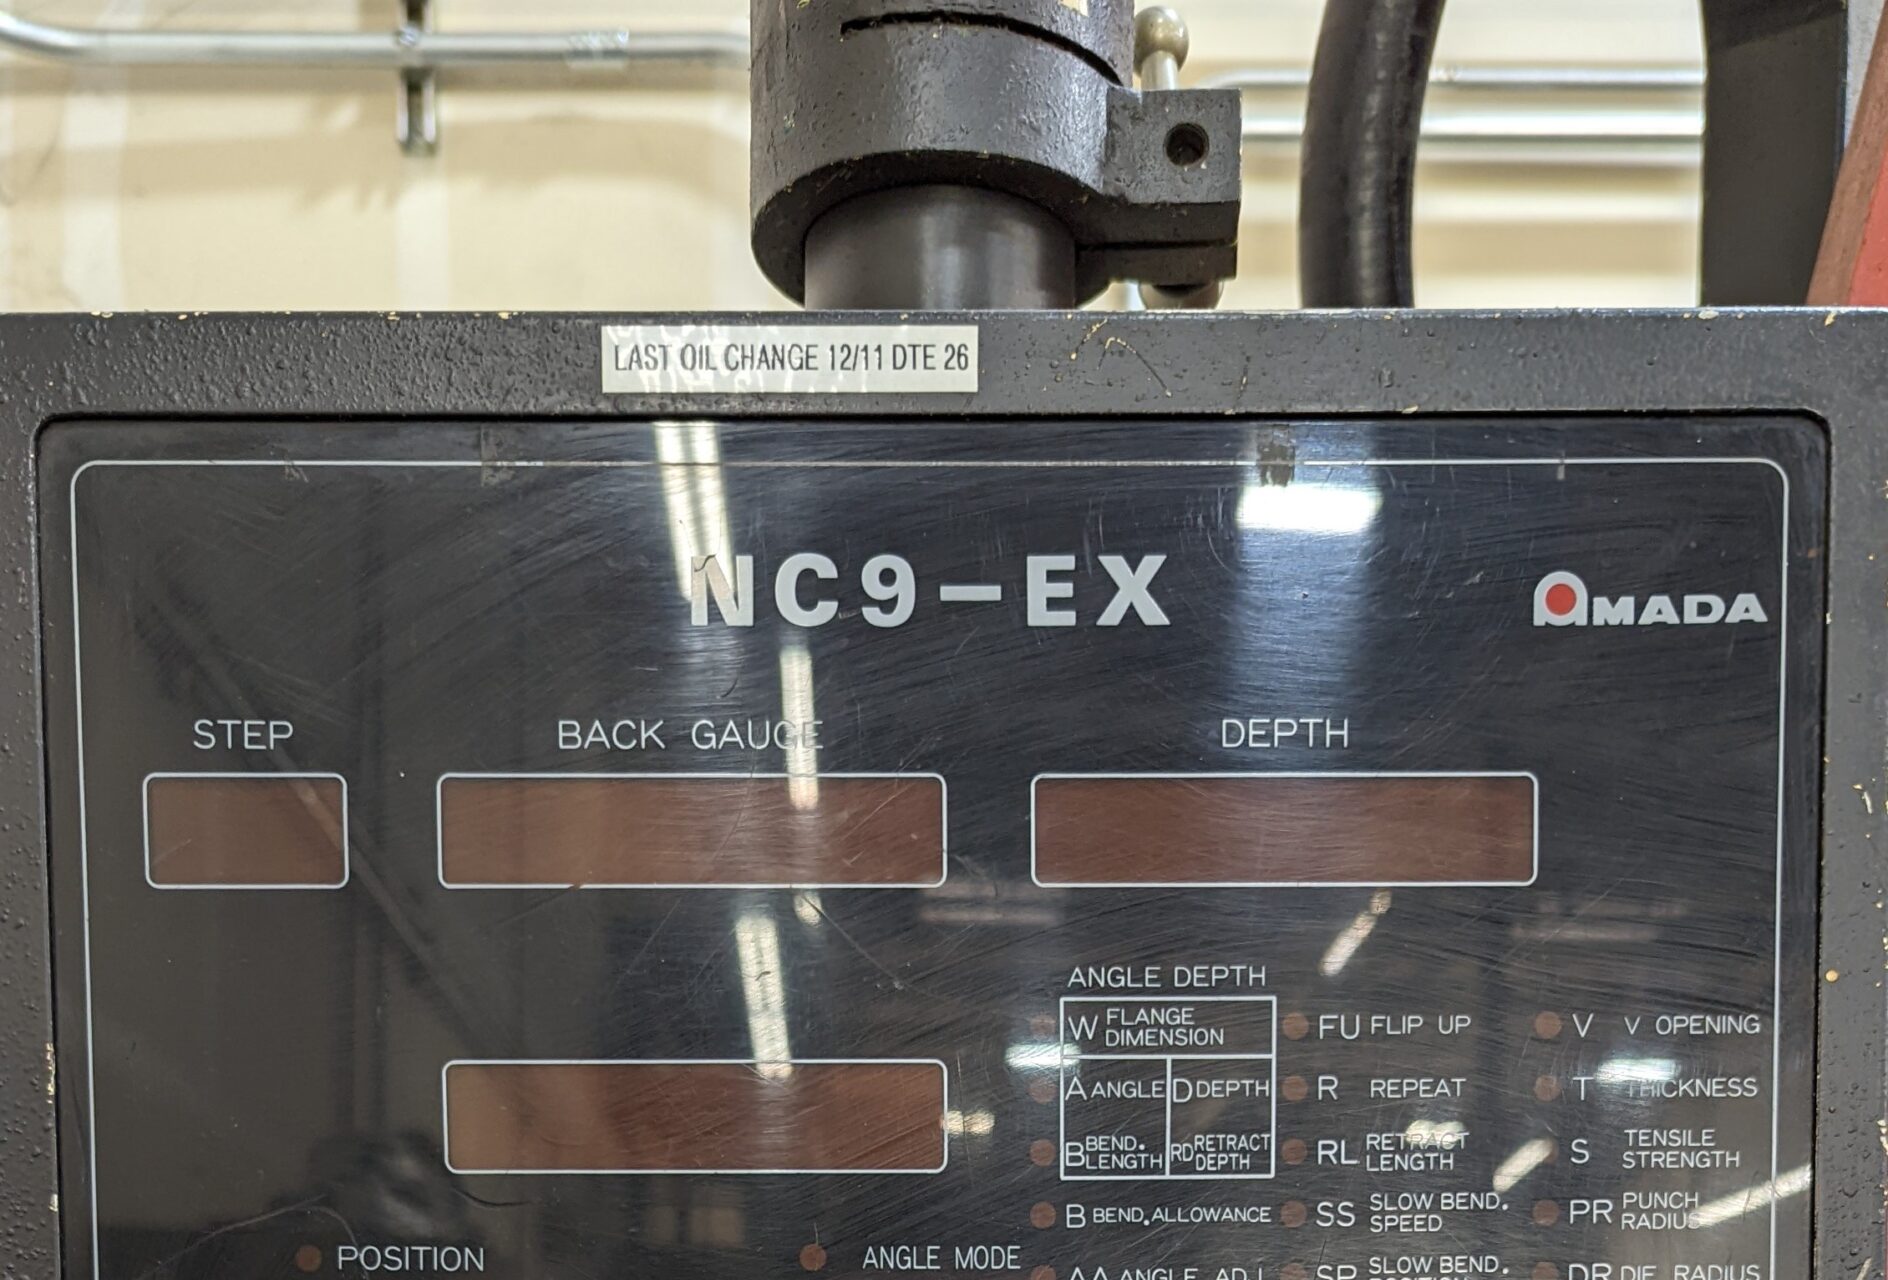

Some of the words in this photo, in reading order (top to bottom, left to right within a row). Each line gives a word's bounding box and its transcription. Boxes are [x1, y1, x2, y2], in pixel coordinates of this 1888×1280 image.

[614, 344, 671, 370] LAST
[680, 344, 714, 370] OIL
[724, 343, 819, 371] CHANGE
[829, 343, 883, 370] 12/11
[893, 343, 936, 369] DTE
[943, 343, 969, 369] 26
[1533, 571, 1768, 626] AMADA
[192, 720, 293, 750] STEP
[558, 721, 664, 750] BACK
[691, 720, 824, 750] GAUGE
[1221, 719, 1349, 749] DEPTH
[1067, 966, 1162, 988] ANGLE
[1173, 966, 1267, 987] DEPTH
[1068, 1016, 1098, 1041] W
[1106, 1008, 1195, 1026] FLANGE
[1319, 1014, 1361, 1040] FU
[1371, 1016, 1424, 1035] FLIP
[1438, 1015, 1472, 1035] UP
[1572, 1013, 1594, 1038] V
[1624, 1016, 1641, 1035] V
[1655, 1015, 1761, 1035] OPENING
[1105, 1029, 1224, 1047] DIMENSION
[1065, 1076, 1087, 1101] A
[1091, 1081, 1165, 1098] ANGLE
[1172, 1079, 1193, 1103] D
[1196, 1080, 1270, 1098] DEPTH
[1318, 1076, 1339, 1100] R
[1370, 1079, 1467, 1098] REPEAT
[1573, 1077, 1594, 1101] T
[1624, 1079, 1758, 1098] THICKNESS
[1085, 1136, 1146, 1151] BEND.
[1194, 1134, 1271, 1152] RETRACT
[1366, 1132, 1470, 1150] RETRACT
[1624, 1129, 1715, 1147] TENSILE
[1065, 1142, 1086, 1167] B
[1085, 1154, 1163, 1170] LENGTH
[1171, 1143, 1193, 1162] RD
[1195, 1154, 1250, 1171] DEPTH
[1317, 1140, 1358, 1165] RL
[1366, 1153, 1454, 1171] LENGTH
[1570, 1139, 1590, 1164] S
[1622, 1151, 1740, 1168] STRENGTH
[1369, 1193, 1434, 1211] SLOW
[1440, 1192, 1509, 1211] BEND.
[1569, 1200, 1613, 1224] PR
[1623, 1192, 1699, 1209] PUNCH
[1066, 1204, 1086, 1228] B
[1315, 1202, 1355, 1227] SS
[1369, 1214, 1442, 1233] SPEED
[1621, 1211, 1700, 1230] RADIUS
[336, 1246, 485, 1272] POSITION
[862, 1246, 940, 1270] ANGLE
[954, 1246, 1021, 1269] MODE
[1368, 1257, 1433, 1275] SLOW
[1439, 1255, 1509, 1275] BEND.
